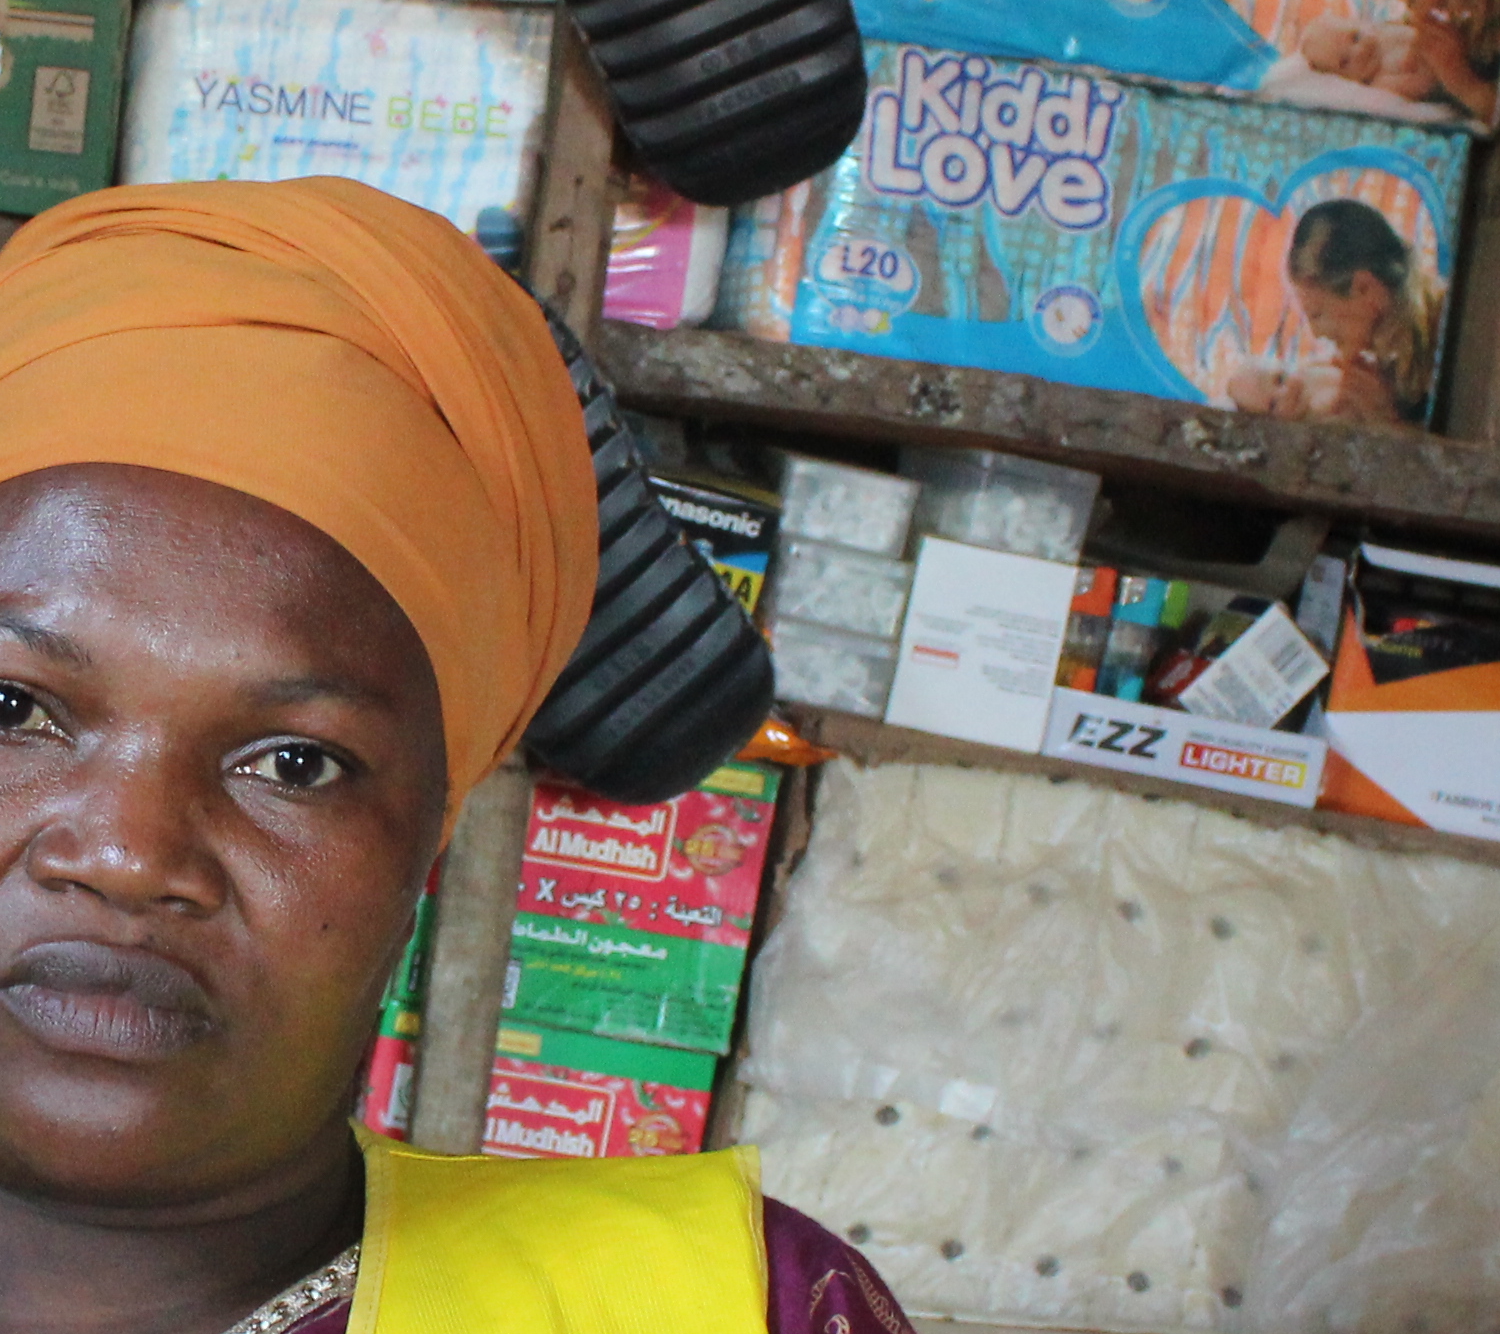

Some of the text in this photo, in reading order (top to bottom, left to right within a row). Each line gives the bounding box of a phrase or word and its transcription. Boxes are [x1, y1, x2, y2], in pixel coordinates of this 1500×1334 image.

[194, 76, 509, 138] YASMINE BEBE
[902, 50, 1126, 161] Kiddi
[868, 94, 1112, 233] Love
[840, 245, 899, 279] L20
[661, 495, 763, 538] nasonic
[1069, 713, 1170, 759] EZZ
[1183, 745, 1303, 787] LIGHTER
[559, 830, 658, 870] Mudhish
[497, 1118, 595, 1158] Mudhish
